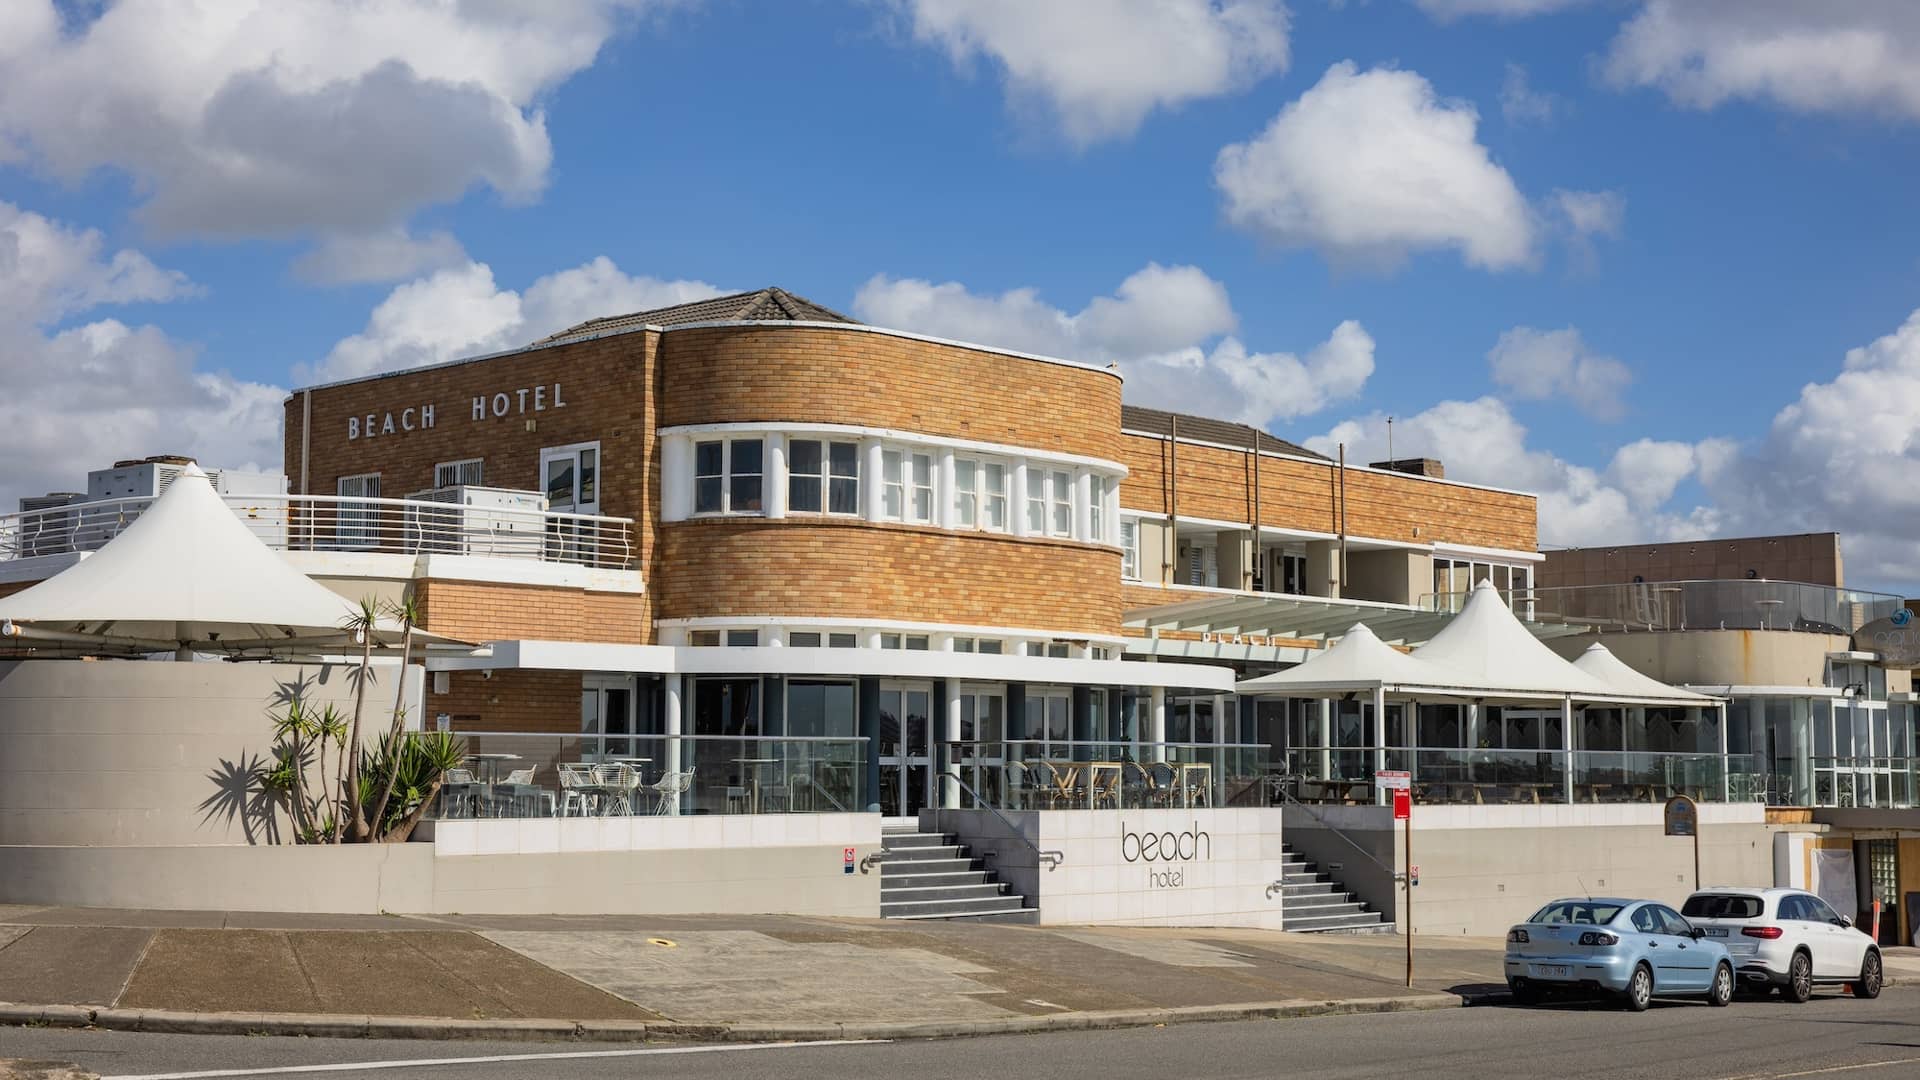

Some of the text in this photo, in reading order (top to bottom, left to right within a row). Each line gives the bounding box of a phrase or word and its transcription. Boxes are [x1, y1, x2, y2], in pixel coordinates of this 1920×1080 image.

[348, 383, 567, 440] BEACH HOTEL
[1122, 819, 1210, 862] beach
[1149, 866, 1185, 888] hotel
